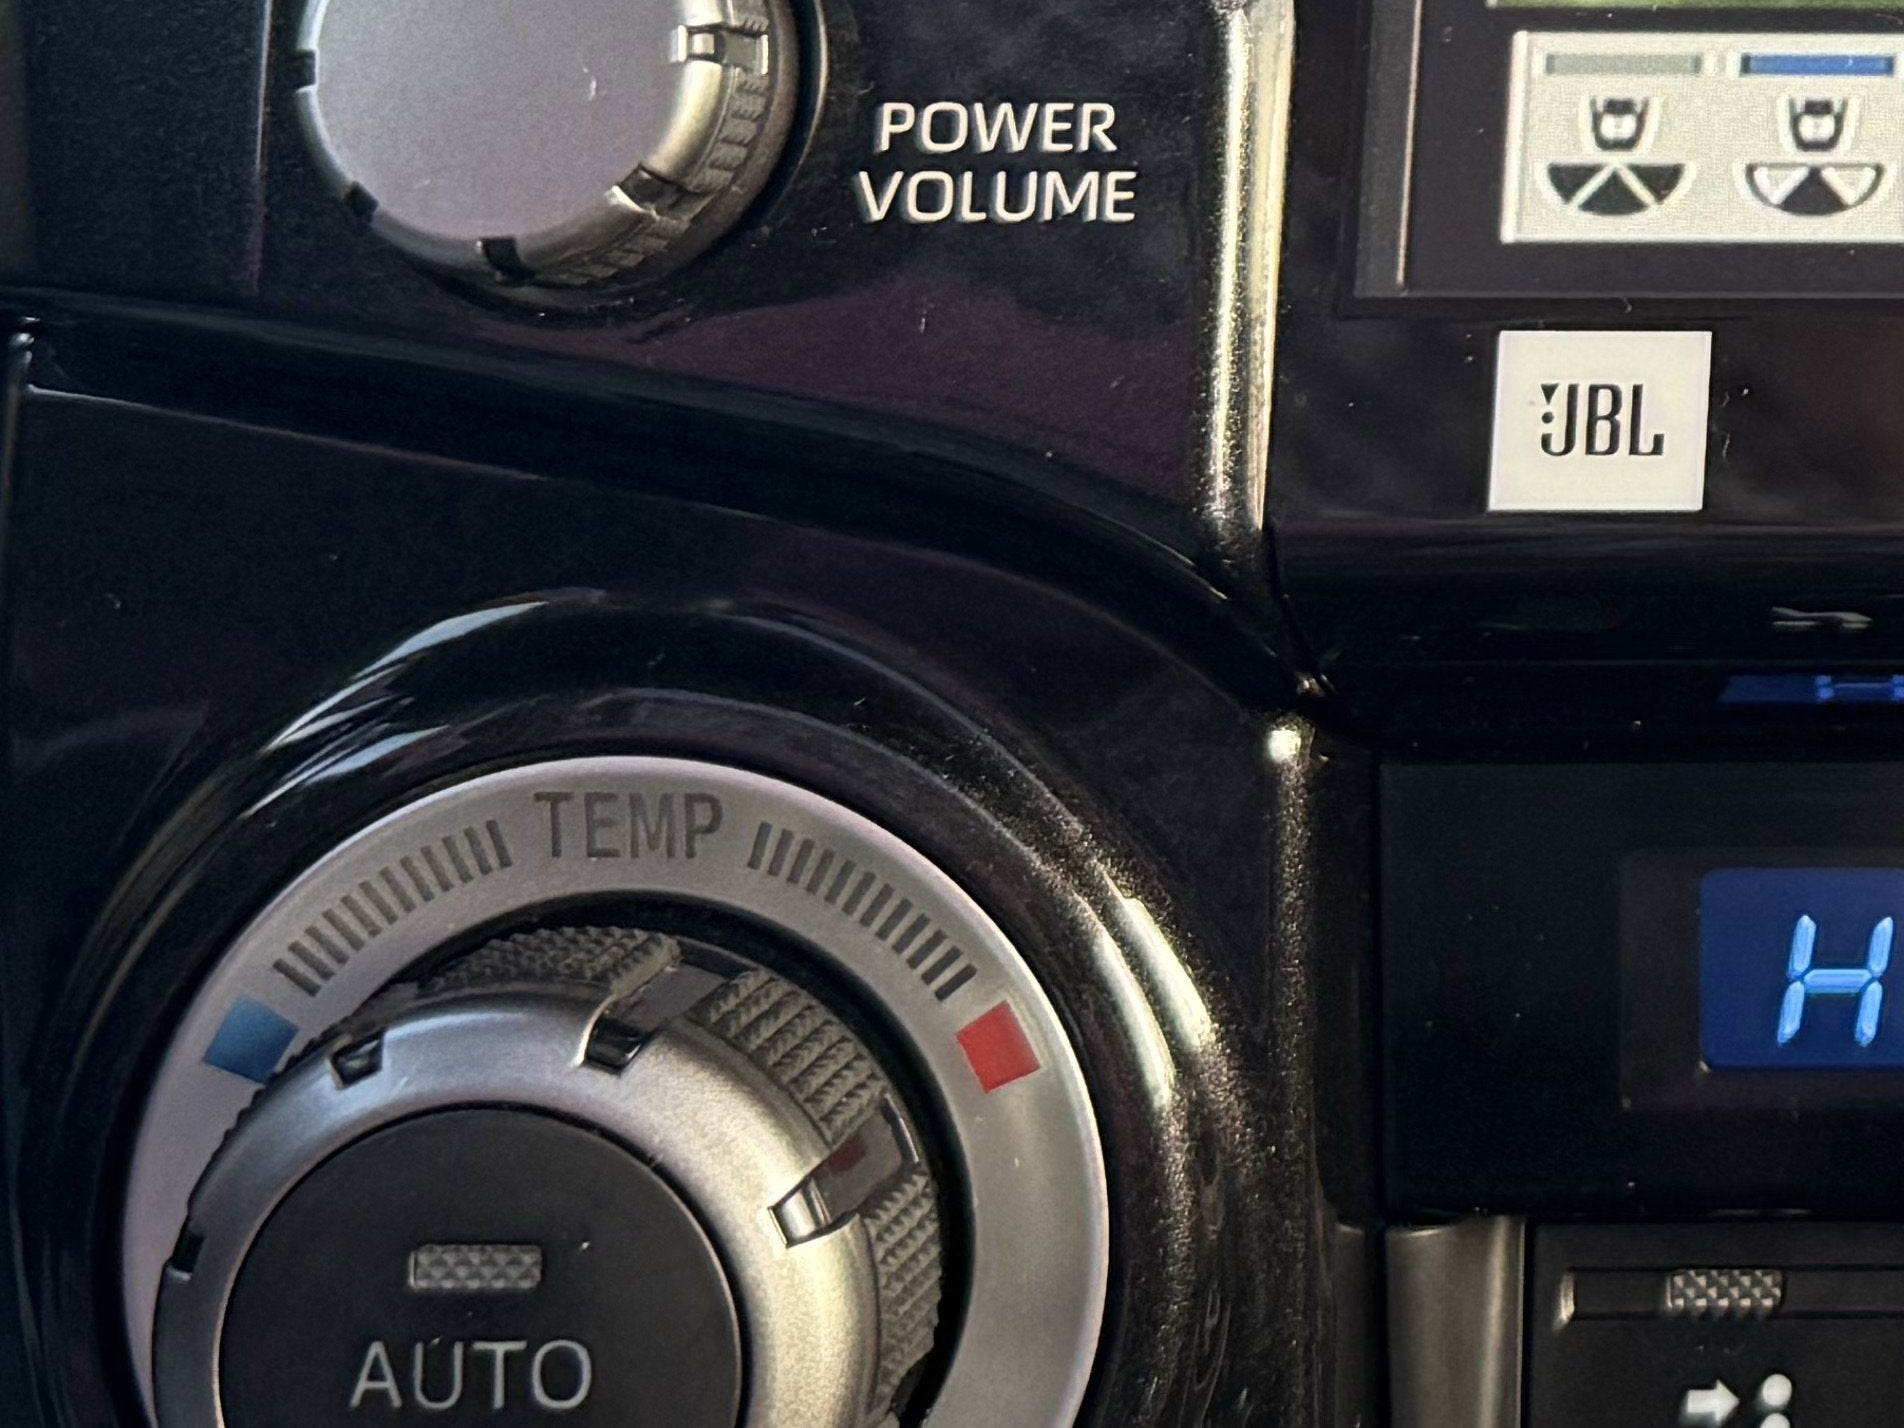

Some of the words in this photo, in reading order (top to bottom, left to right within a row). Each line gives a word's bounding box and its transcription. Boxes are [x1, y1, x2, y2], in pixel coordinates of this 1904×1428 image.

[873, 100, 1119, 154] POWER
[855, 169, 1138, 224] VOLUME
[1539, 382, 1666, 457] JBL
[532, 789, 724, 860] TEMP
[349, 1338, 594, 1412] AUTO
